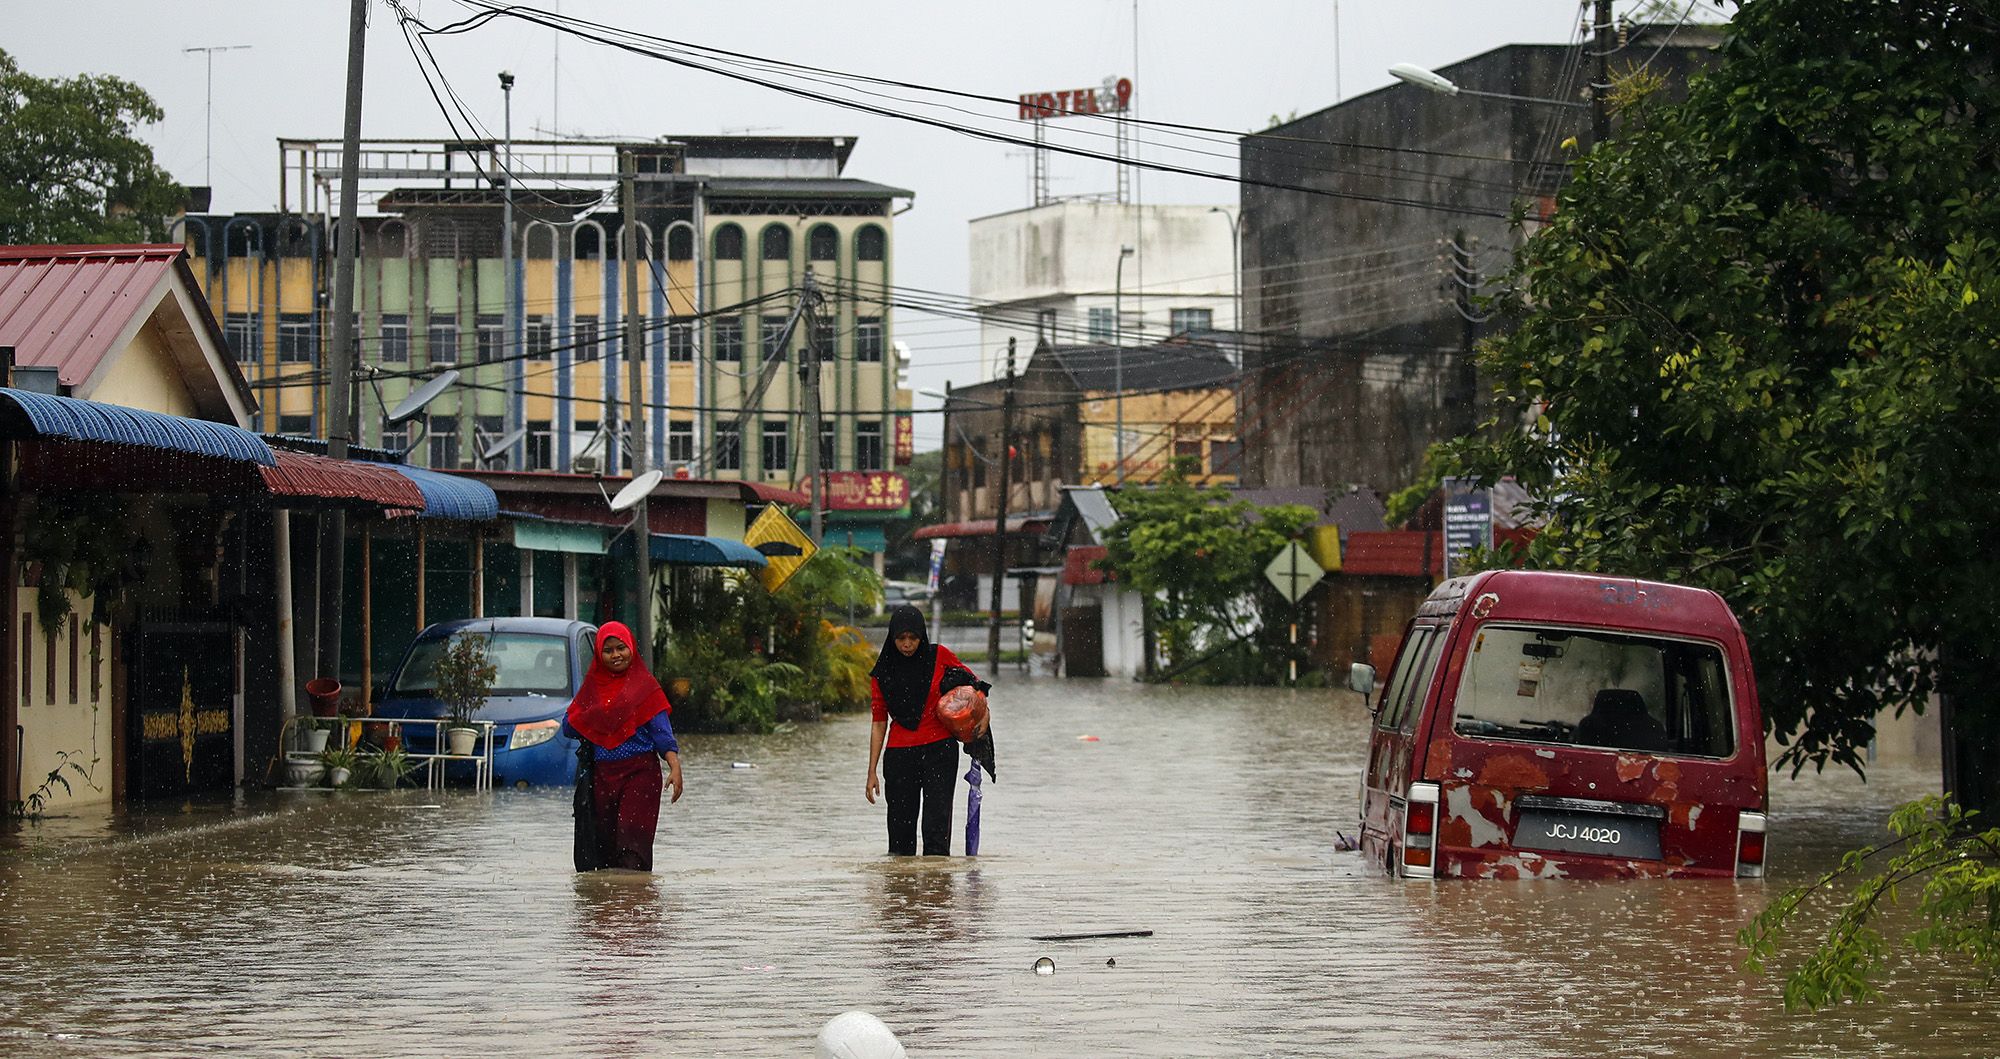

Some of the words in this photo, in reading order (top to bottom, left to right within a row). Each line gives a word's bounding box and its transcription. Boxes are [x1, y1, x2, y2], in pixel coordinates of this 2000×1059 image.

[1019, 88, 1099, 120] HOTEL
[1545, 823, 1578, 840] JCJ
[1580, 826, 1621, 844] 4020
